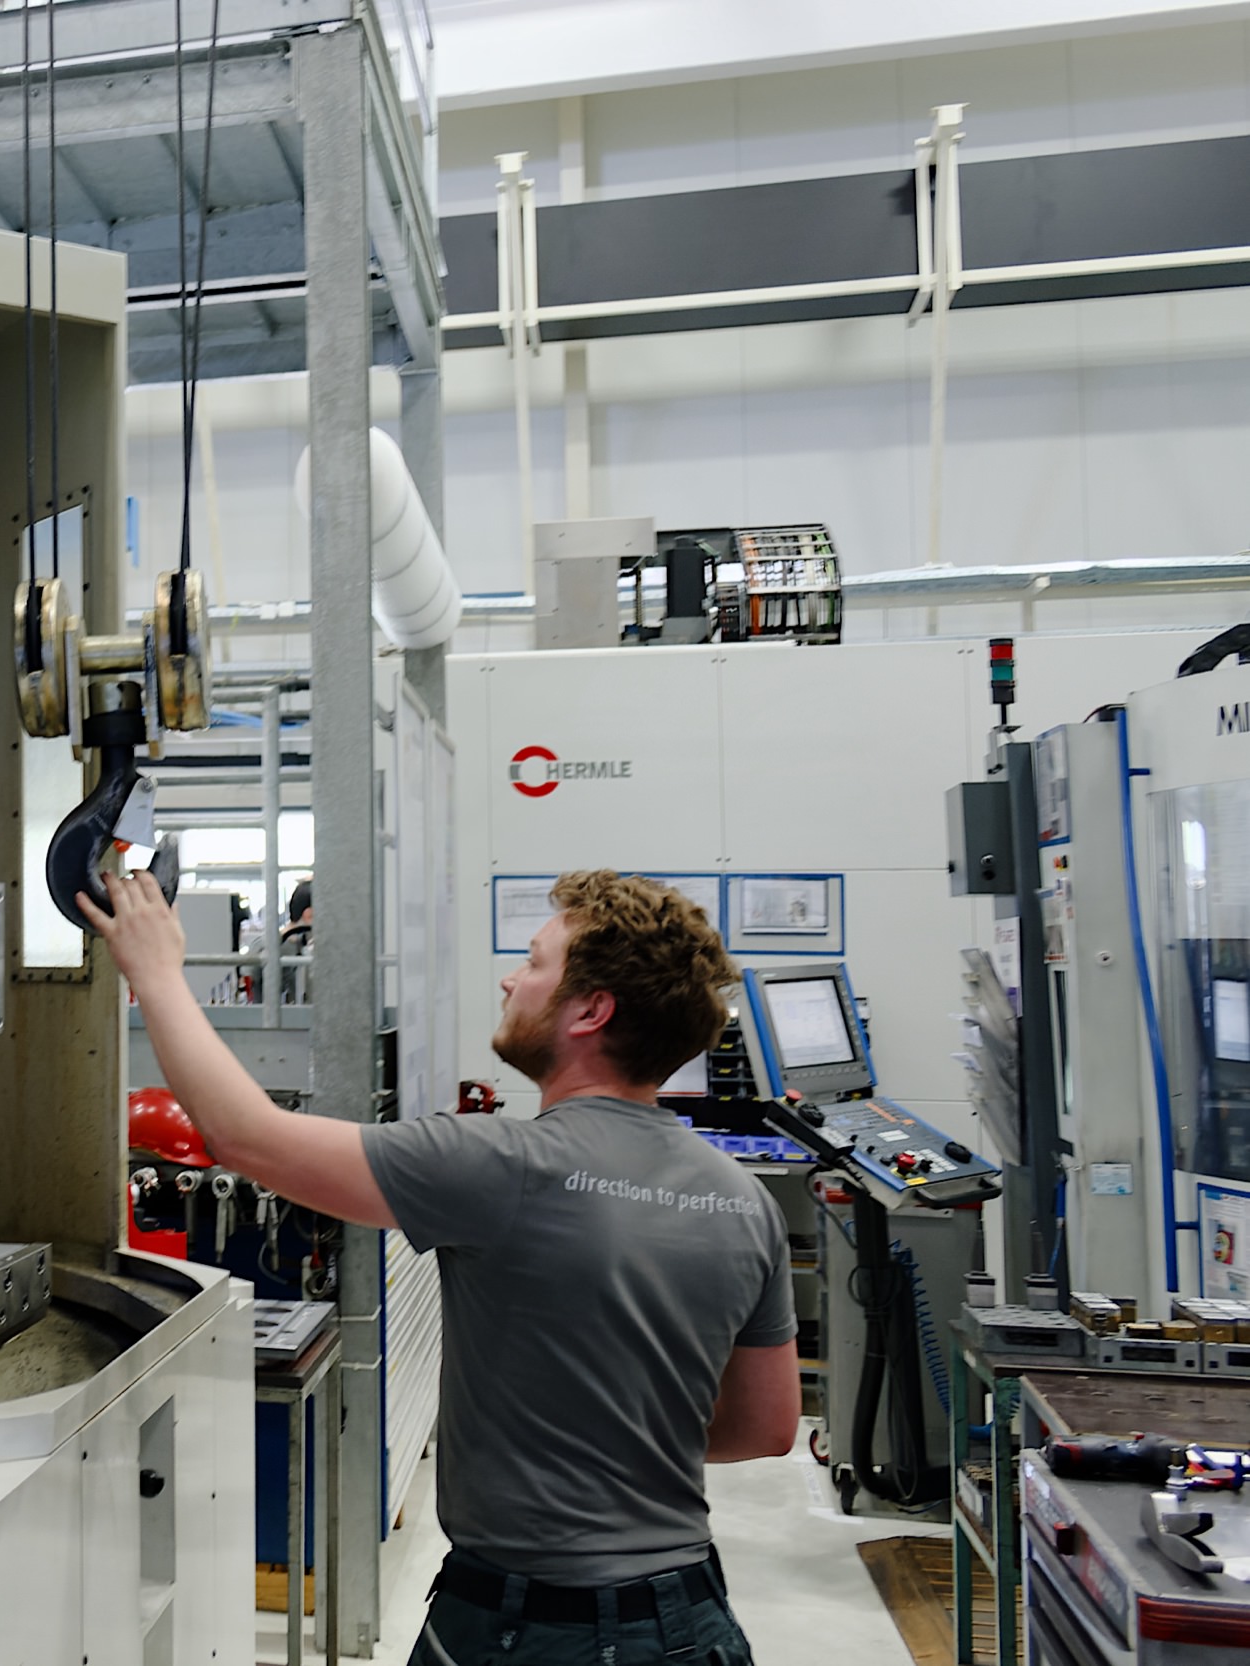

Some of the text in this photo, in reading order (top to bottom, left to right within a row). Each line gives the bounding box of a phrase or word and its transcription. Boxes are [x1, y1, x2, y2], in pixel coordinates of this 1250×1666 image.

[546, 761, 632, 780] HERMLE
[564, 1170, 653, 1202] direction
[656, 1187, 676, 1207] to
